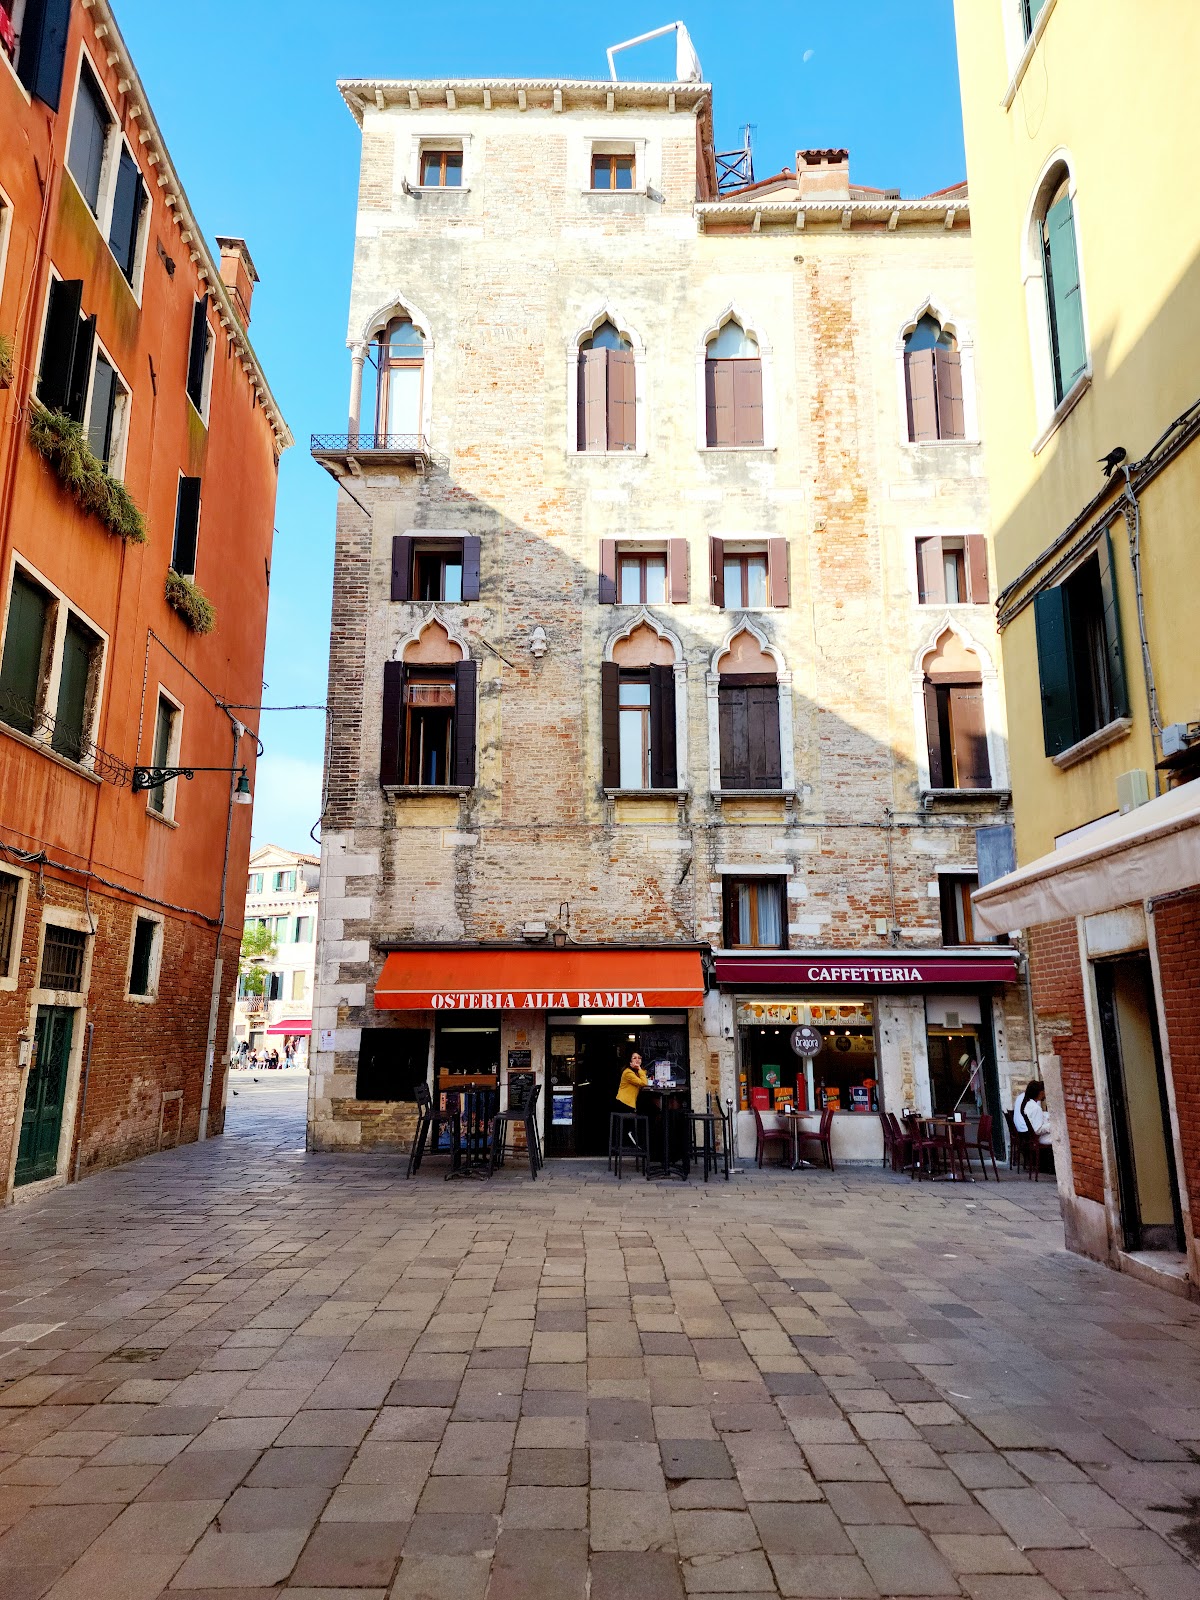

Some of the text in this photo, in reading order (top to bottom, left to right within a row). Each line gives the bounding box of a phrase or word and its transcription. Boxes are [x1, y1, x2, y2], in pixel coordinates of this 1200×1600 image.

[807, 967, 923, 982] CAFFETTERIA
[431, 992, 646, 1009] OSTERIA ALLA RAMPA
